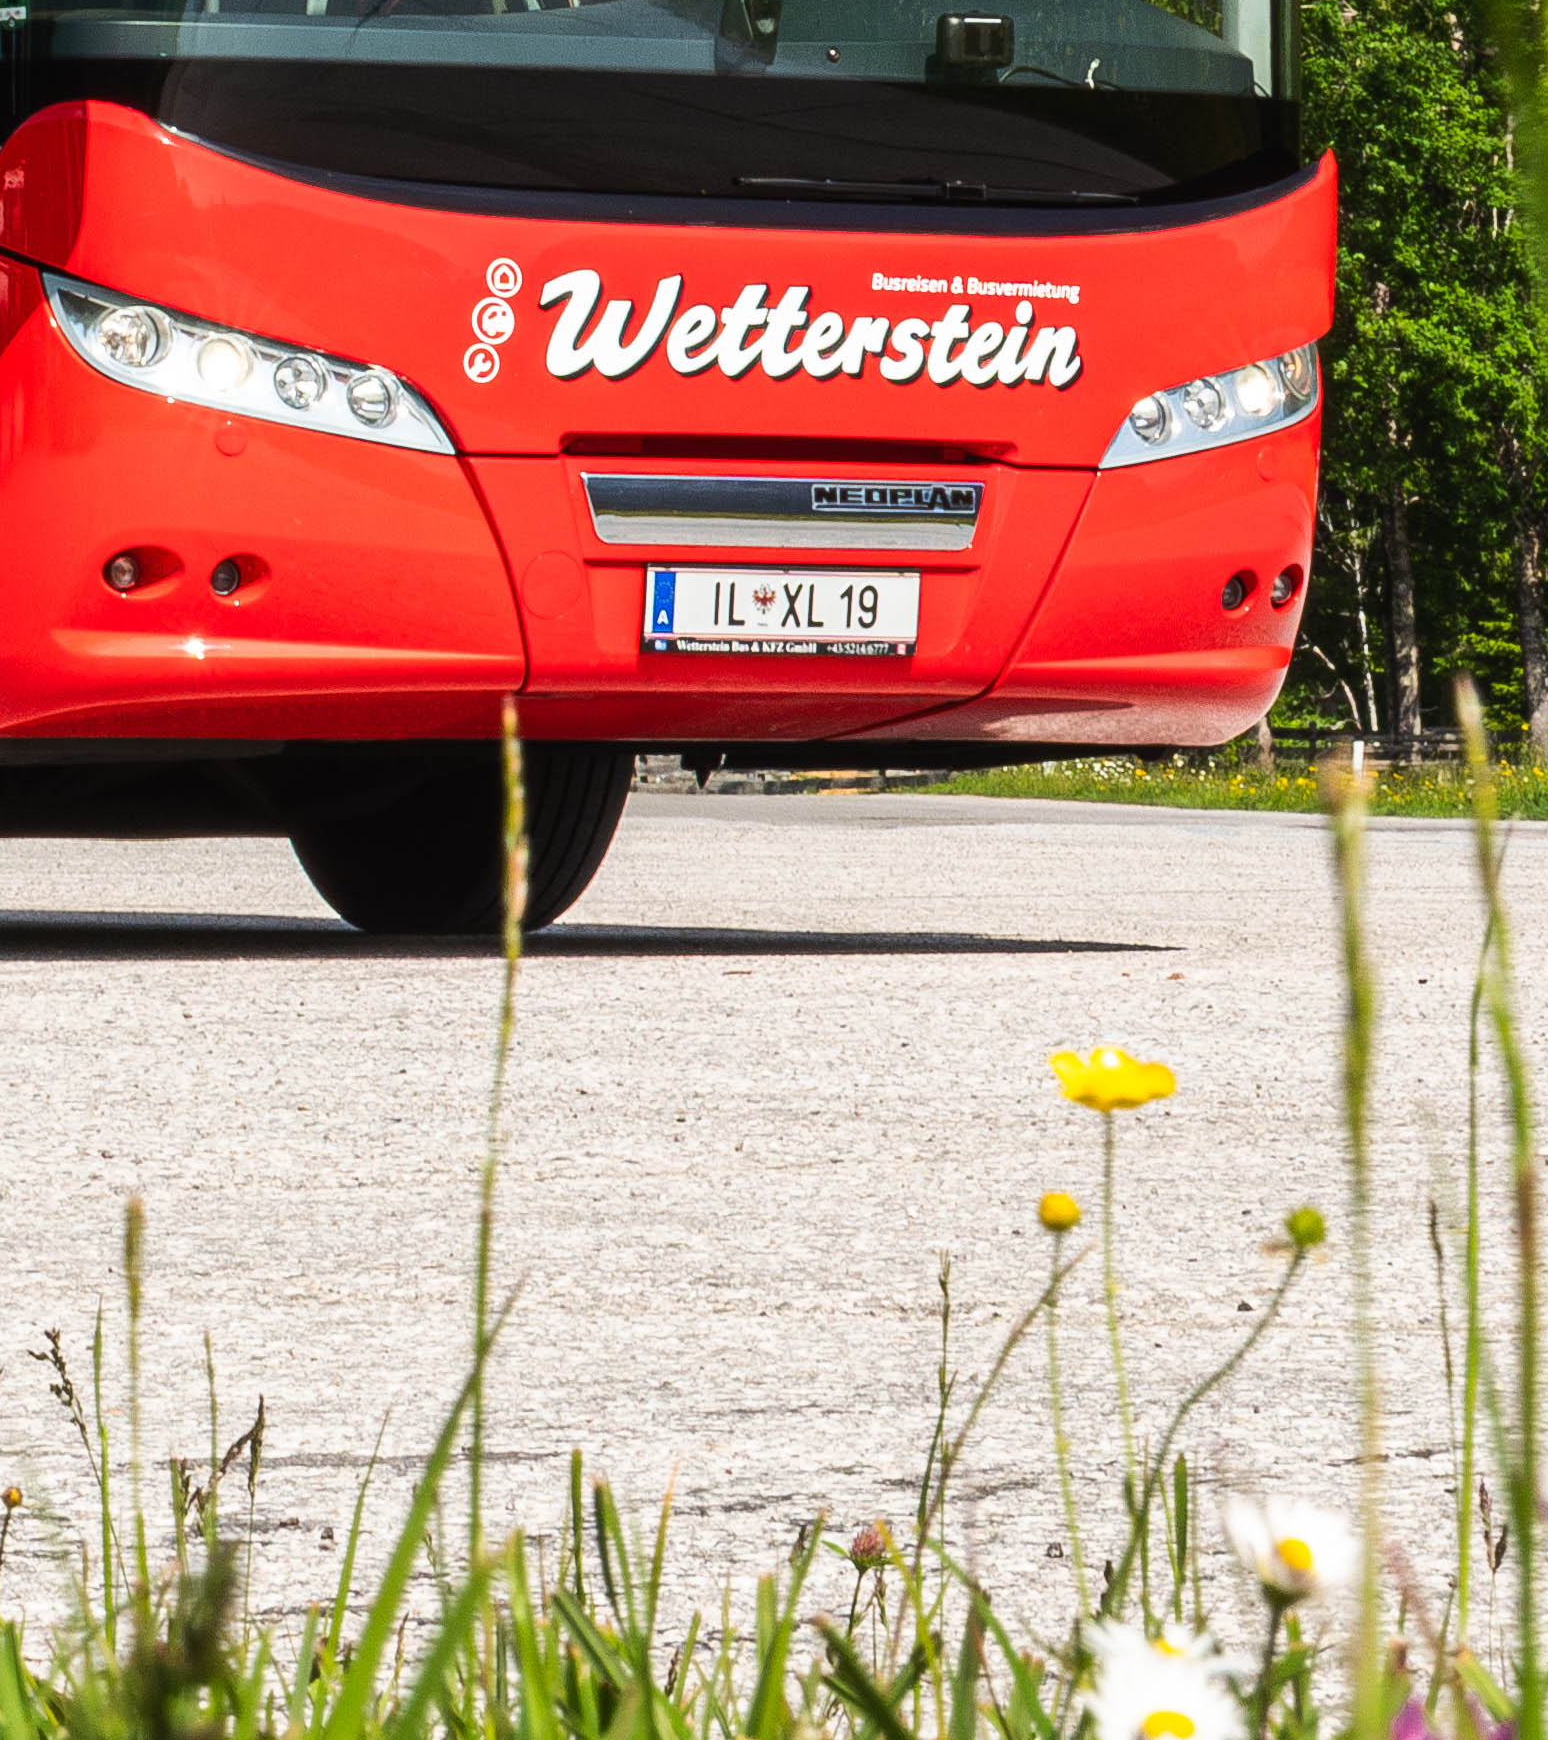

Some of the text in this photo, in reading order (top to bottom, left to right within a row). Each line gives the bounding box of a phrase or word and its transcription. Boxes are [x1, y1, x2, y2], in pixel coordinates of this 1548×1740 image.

[871, 272, 1081, 305] Busreisen & Busvermietung
[539, 269, 1082, 389] Wetterstein
[813, 485, 975, 510] NEOPLAN
[656, 609, 669, 625] A
[713, 581, 879, 629] IL XL 19
[676, 639, 730, 652] Wetterstein
[731, 640, 749, 652] Bus
[750, 641, 760, 652] &
[762, 641, 784, 653] KFZ
[785, 641, 817, 654] GmbH
